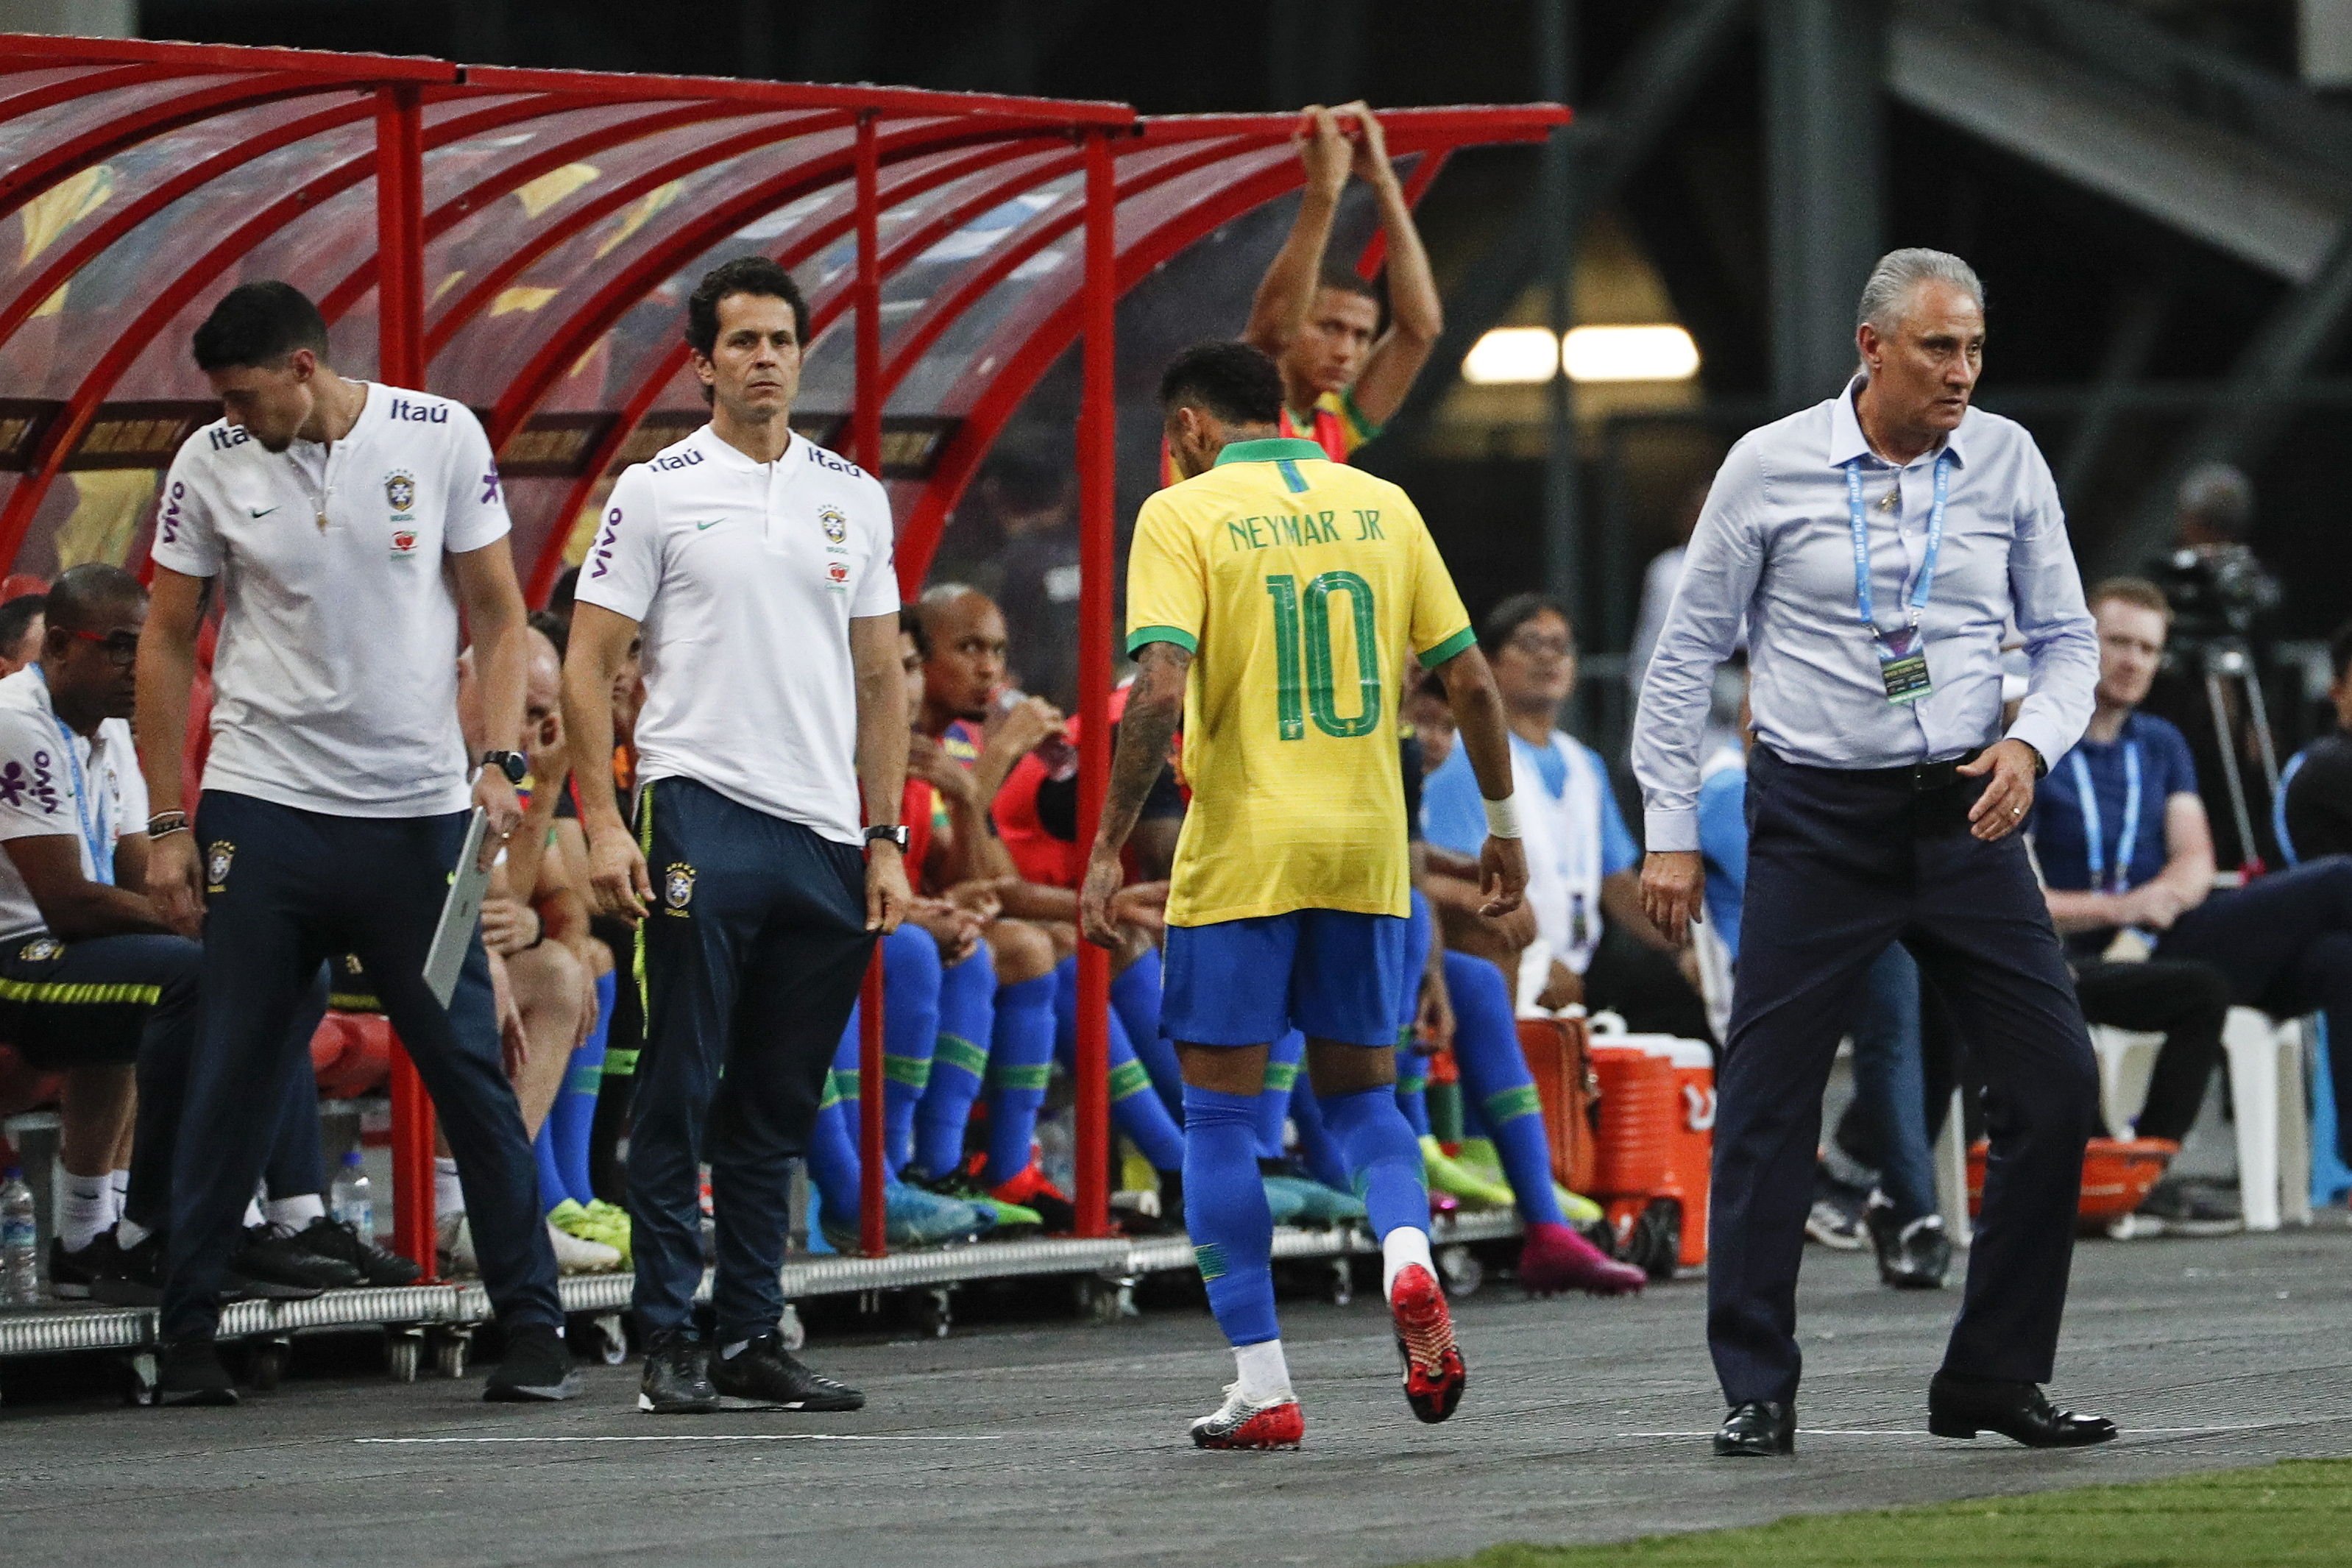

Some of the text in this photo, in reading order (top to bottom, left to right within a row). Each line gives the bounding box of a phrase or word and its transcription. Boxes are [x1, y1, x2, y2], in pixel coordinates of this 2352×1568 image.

[209, 428, 250, 451] Ita
[391, 399, 448, 424] Itaú
[162, 481, 185, 543] vivo
[592, 508, 623, 578] vivo
[1228, 510, 1385, 551] NEYMAR JR
[1266, 570, 1381, 741] 10
[29, 751, 57, 814] vivo
